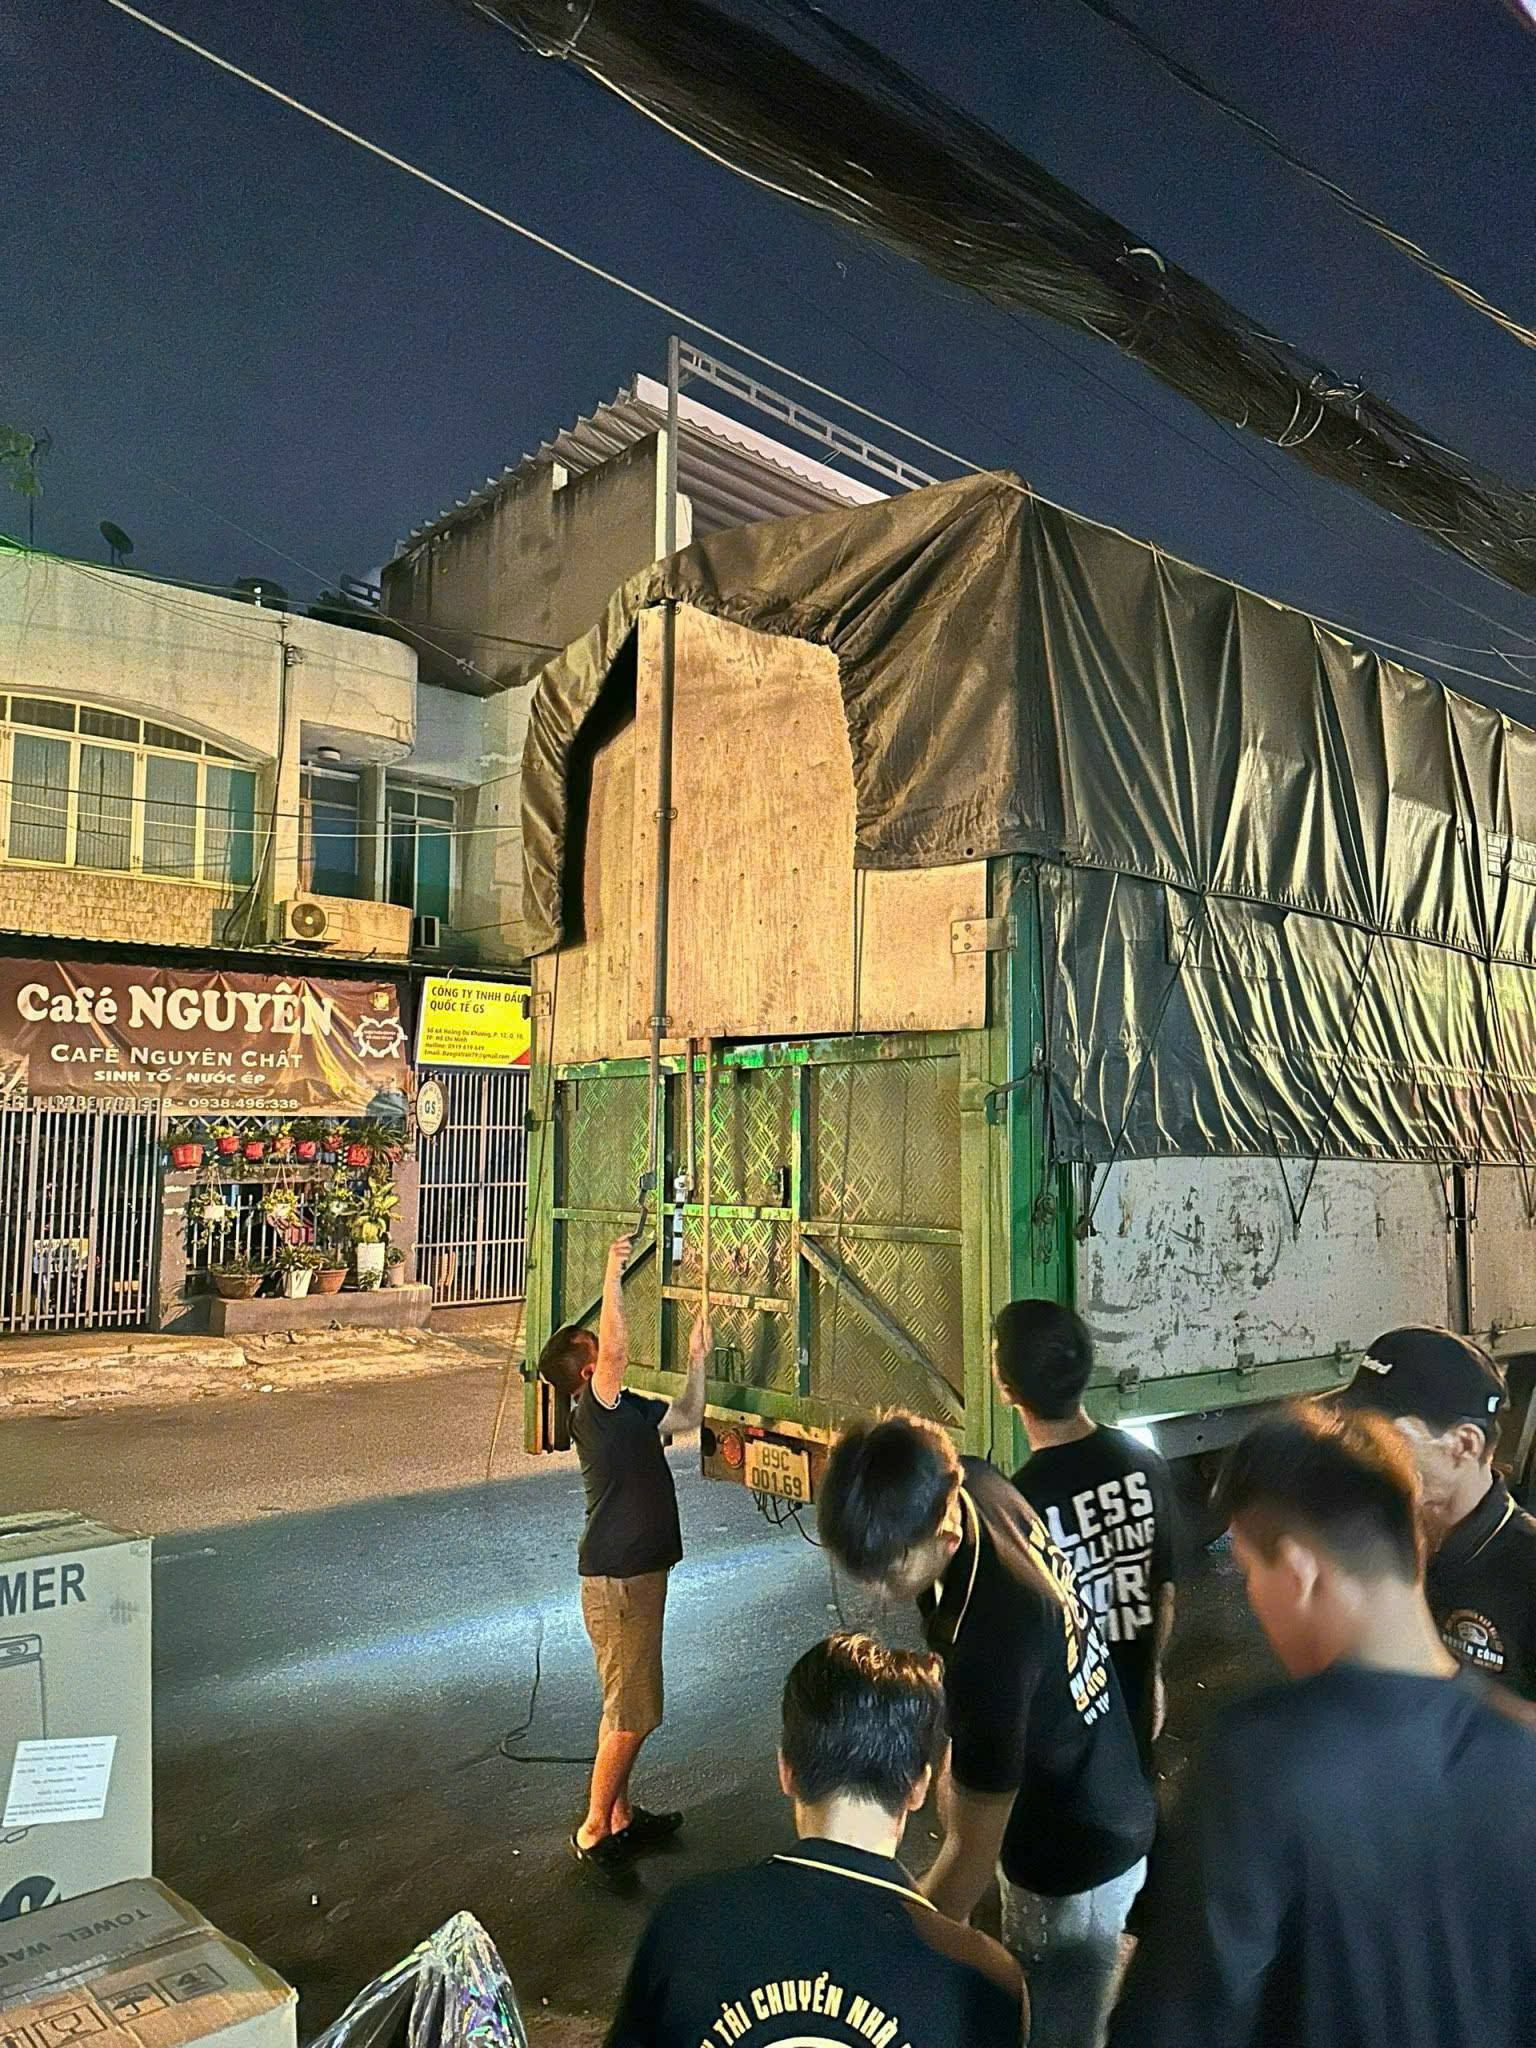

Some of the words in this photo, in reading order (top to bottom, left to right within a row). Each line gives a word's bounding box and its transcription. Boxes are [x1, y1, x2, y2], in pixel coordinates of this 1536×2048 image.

[17, 983, 118, 1025] Café
[128, 981, 333, 1037] NGUYÊN
[430, 998, 456, 1011] QUỐC
[473, 1004, 485, 1014] GS
[462, 989, 473, 999] TY
[476, 990, 501, 1002] TNHH
[50, 1043, 120, 1064] CAFÉ
[130, 1047, 233, 1067] NGUYÊN
[94, 1070, 141, 1083] SINH
[145, 1066, 173, 1083] TỐ
[186, 1070, 236, 1084] NƯỚC
[241, 1071, 266, 1085] ÉP
[188, 1097, 299, 1110] 0938.496.338
[424, 1099, 437, 1115] GS
[762, 1446, 791, 1472] 89C
[752, 1466, 803, 1498] 001.69
[1045, 1471, 1154, 1549] LESS
[1064, 1517, 1155, 1574] ALKING
[0, 1563, 87, 1617] MER
[57, 1908, 153, 1942] TOWEL
[750, 1971, 844, 2021] CHUYỂN
[845, 1994, 899, 2048] NHÀ
